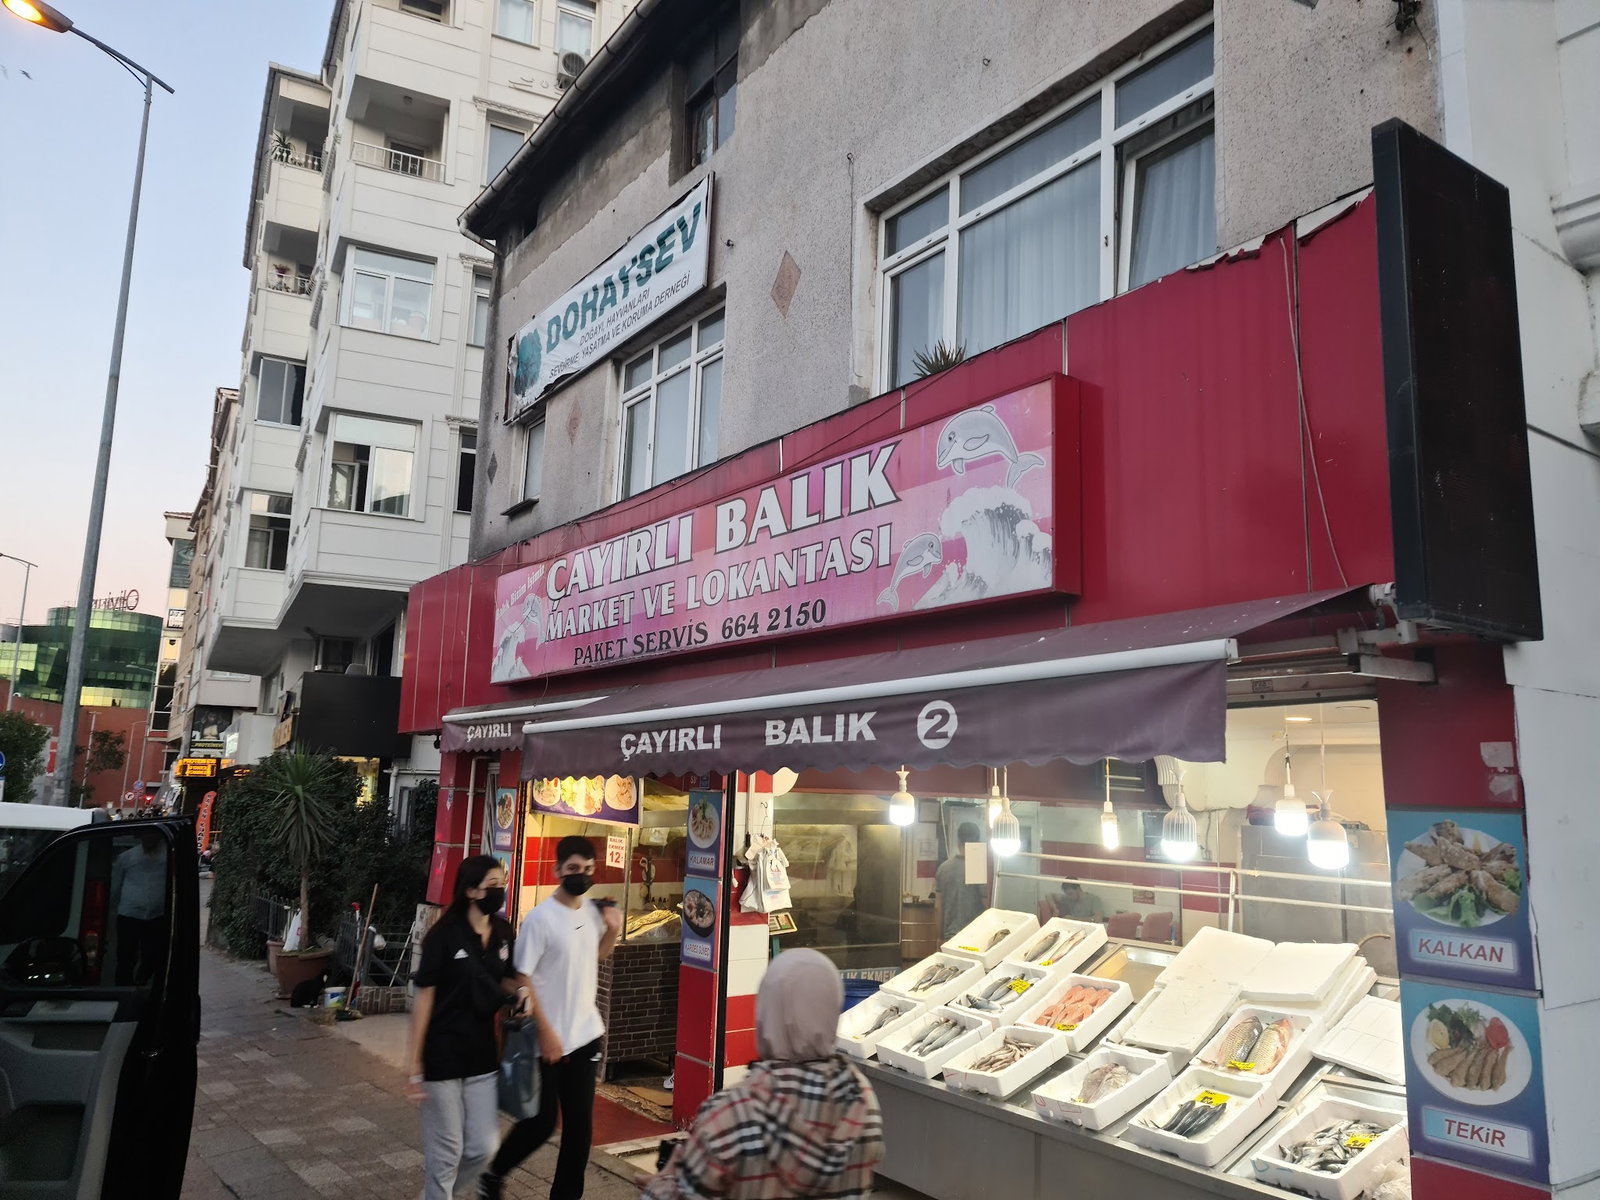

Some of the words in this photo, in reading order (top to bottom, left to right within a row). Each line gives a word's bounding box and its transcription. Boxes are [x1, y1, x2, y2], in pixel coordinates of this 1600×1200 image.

[547, 201, 701, 354] DOHAYSEV
[606, 288, 650, 327] HAYVANLARI
[581, 331, 611, 359] YAŞATMA
[611, 325, 622, 340] VE
[622, 302, 653, 332] KORUMA
[653, 270, 691, 309] DERNEĞİ
[545, 512, 694, 610] ÇAYIRLI
[714, 440, 902, 555] BALIK
[545, 590, 635, 642] MARKET
[642, 581, 675, 619] VE
[686, 522, 893, 610] LOKANTASI
[573, 634, 628, 666] PAKET
[632, 618, 709, 656] SERVİS
[721, 611, 760, 640] 664
[768, 599, 827, 631] 2150
[466, 722, 512, 742] ÇAYIRLI
[620, 724, 723, 762] ÇAYIRLI
[764, 711, 877, 747] BALIK
[923, 707, 951, 740] 2
[1418, 938, 1504, 963] KALKAN
